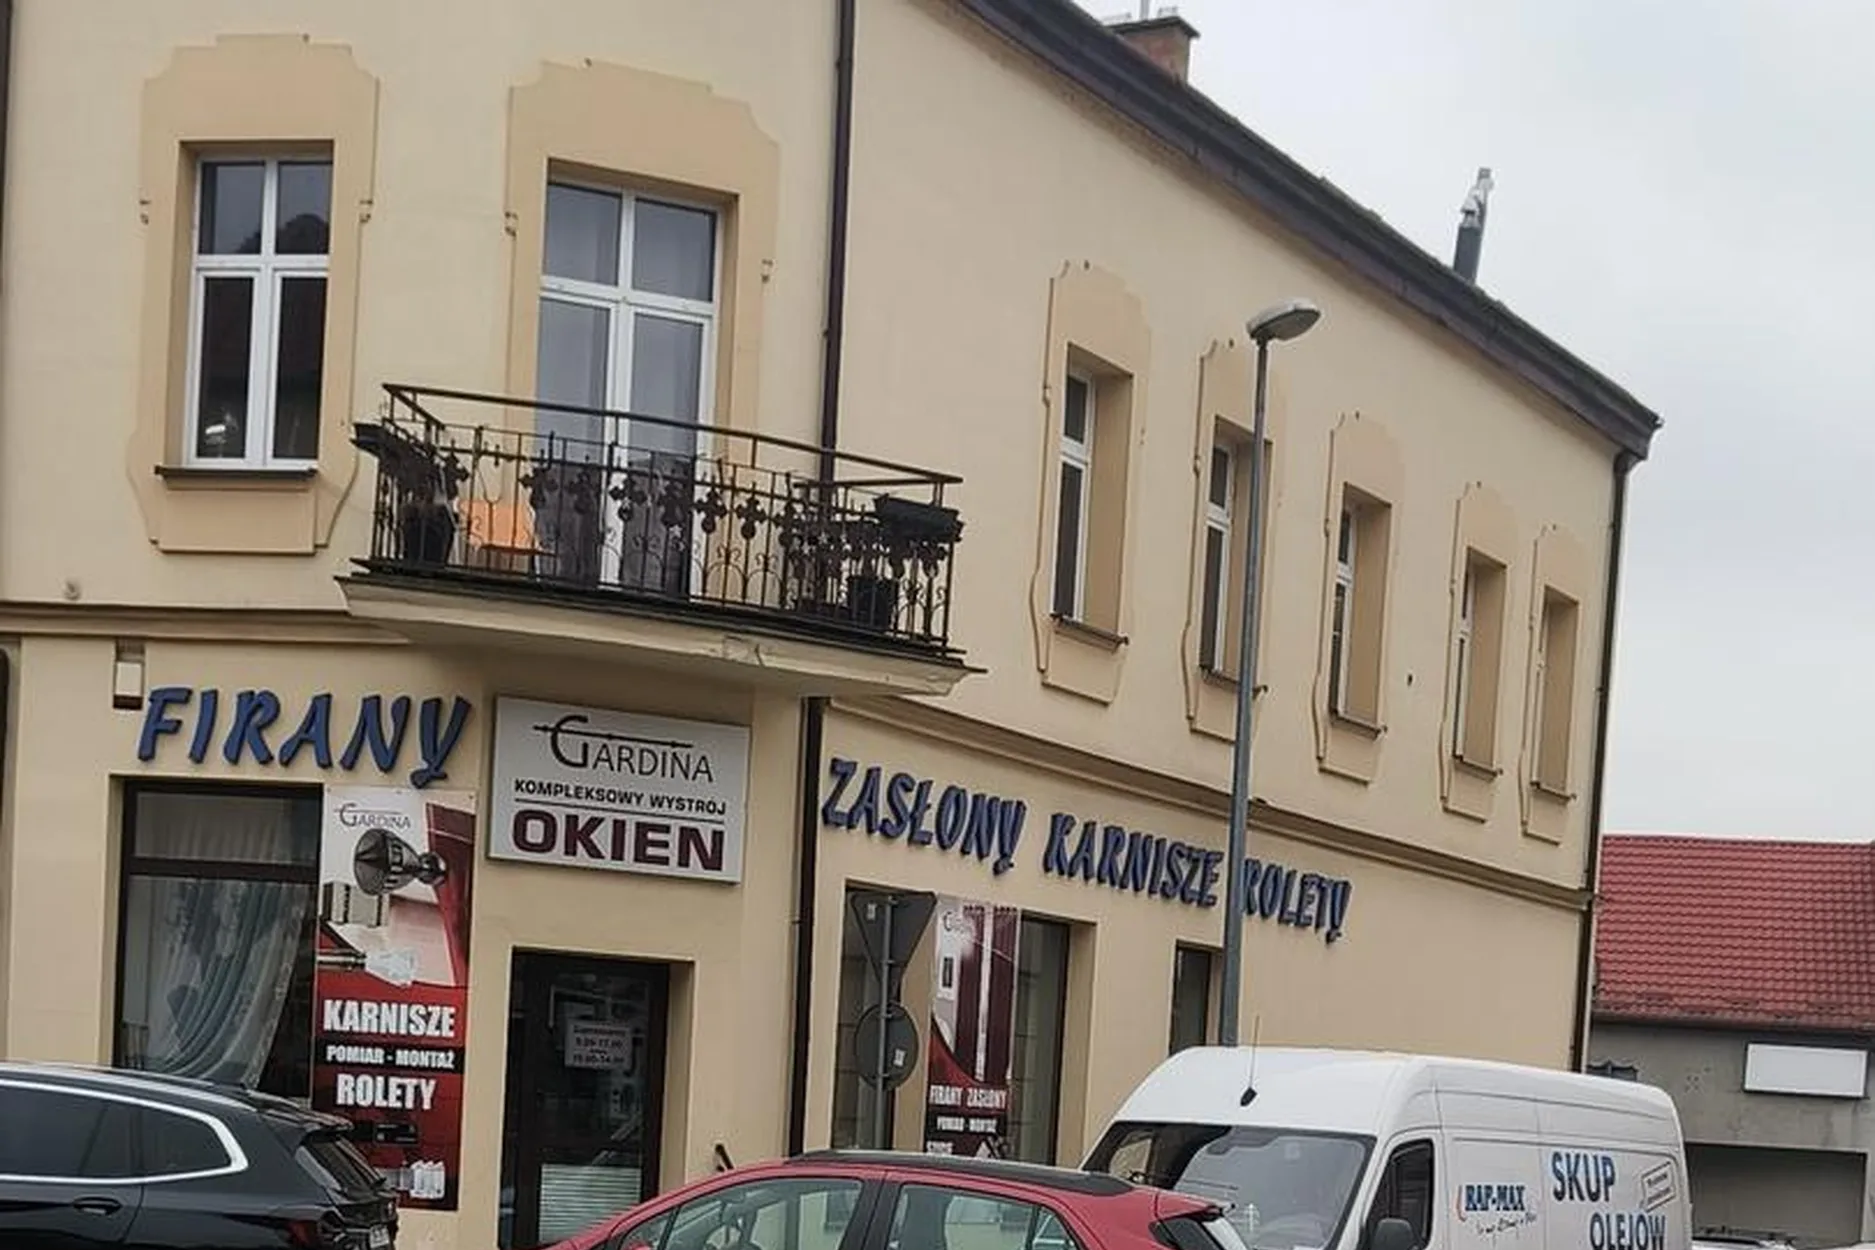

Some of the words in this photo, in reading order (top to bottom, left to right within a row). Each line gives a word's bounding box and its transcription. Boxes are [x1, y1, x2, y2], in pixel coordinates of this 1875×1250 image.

[137, 687, 473, 789] FIRANY
[550, 714, 714, 783] GARDINA
[339, 802, 411, 828] GARDINA
[514, 779, 645, 807] KOMPLEKSOWY
[649, 794, 727, 816] WYSTRÓJ
[512, 809, 724, 872] OKIEN
[822, 757, 1027, 876] ZASŁONY
[1042, 812, 1225, 908] KARNISZE
[1243, 858, 1353, 946] ROLETY
[323, 1000, 456, 1039] KARNISZE
[326, 1045, 385, 1066] POMIAR
[395, 1048, 455, 1070] MONTAŻ
[335, 1073, 437, 1110] ROLETY
[1551, 1151, 1616, 1202] SKUP
[1465, 1184, 1526, 1212] RAP-MAX
